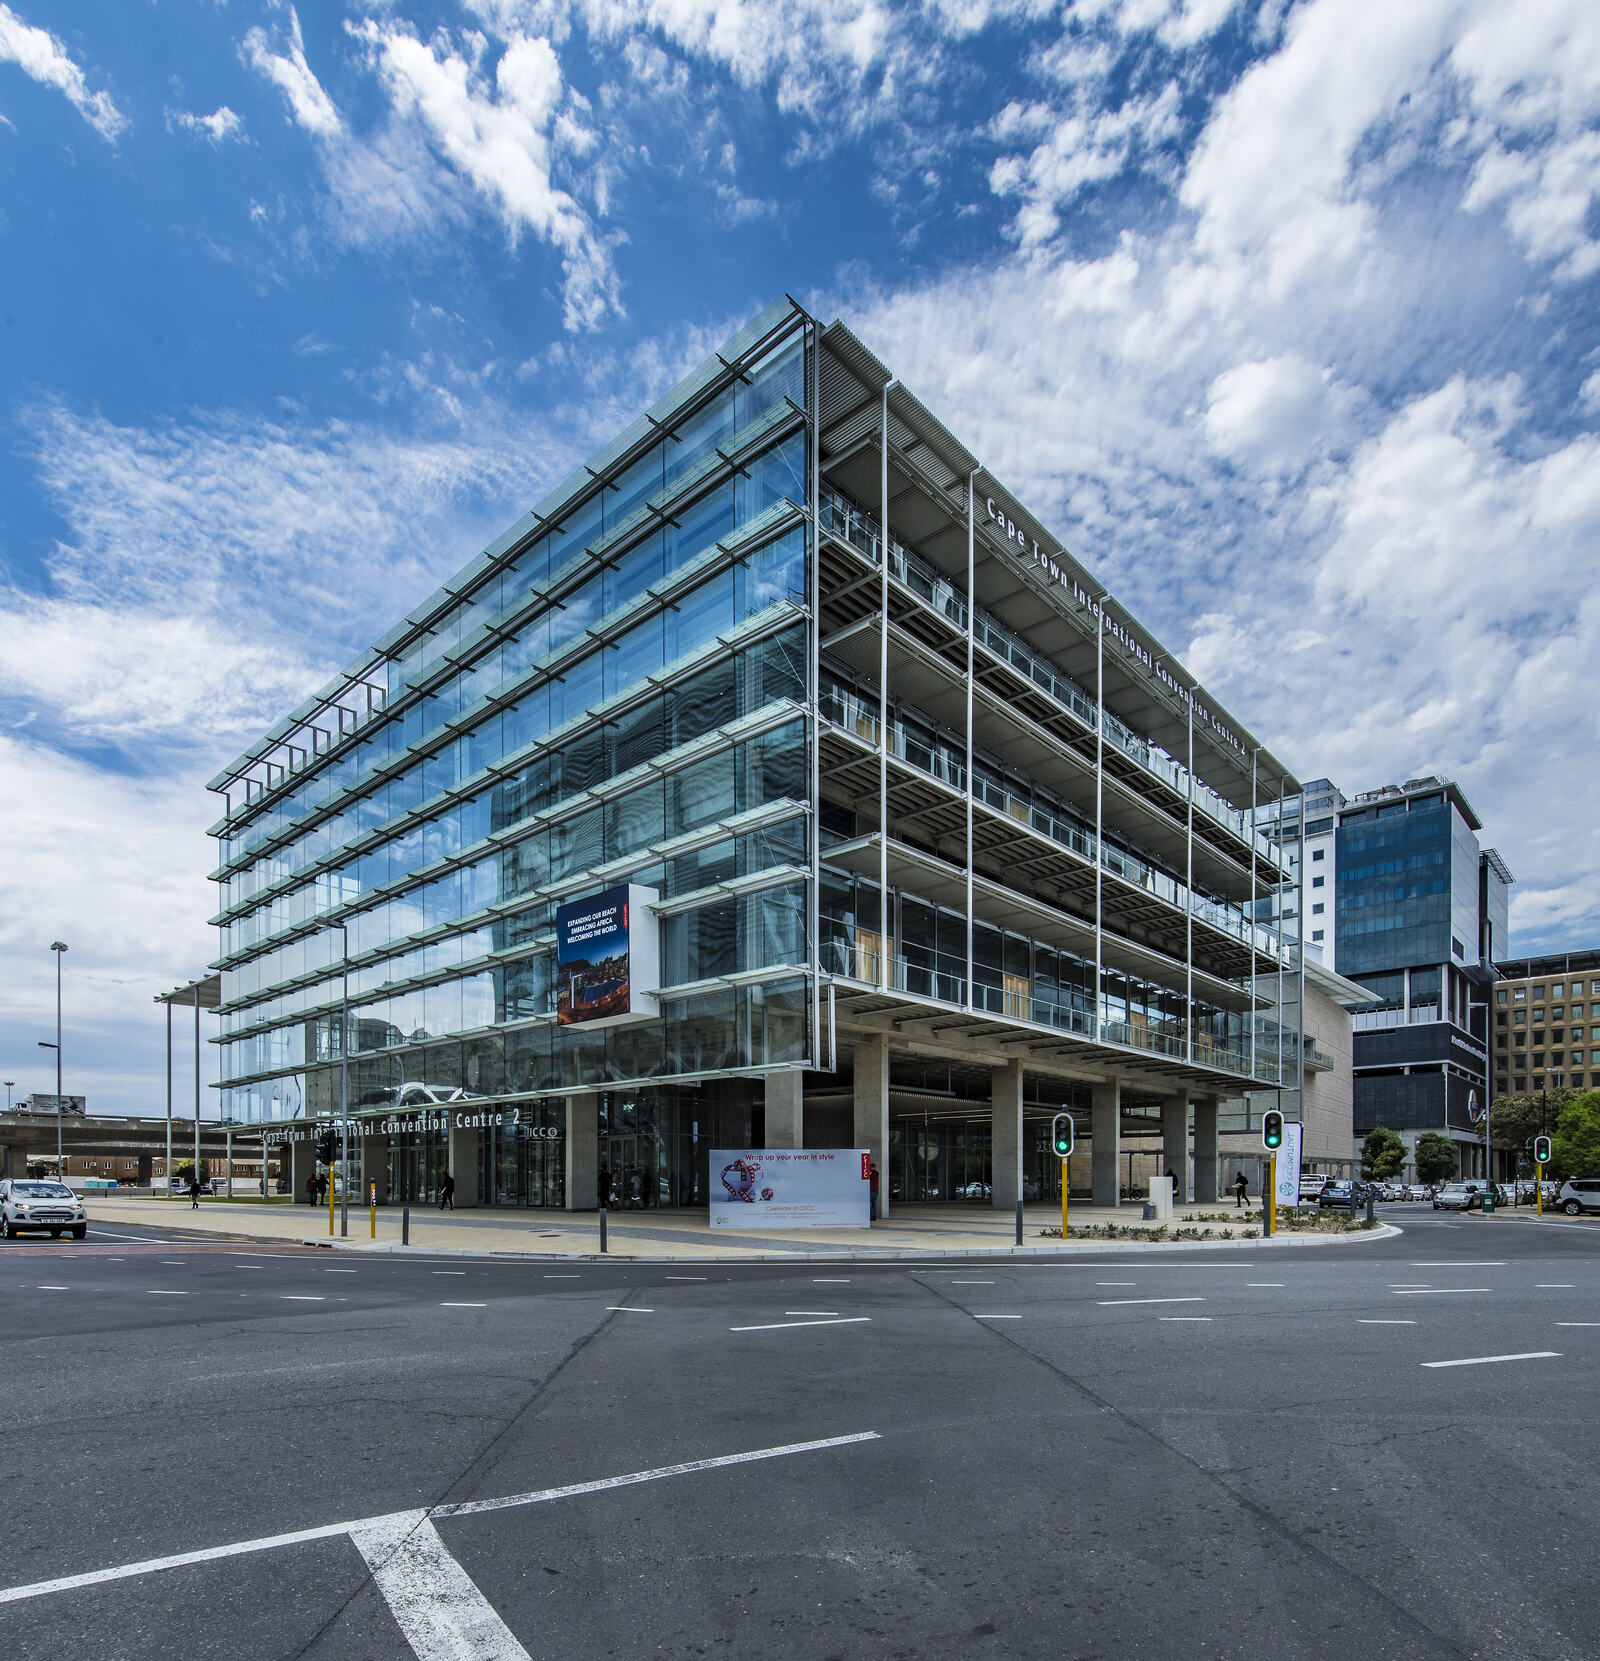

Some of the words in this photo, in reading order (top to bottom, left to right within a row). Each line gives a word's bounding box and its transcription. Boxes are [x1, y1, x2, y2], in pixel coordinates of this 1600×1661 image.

[987, 498, 1024, 546] Cape
[1033, 539, 1067, 588] Town
[1074, 581, 1152, 668] International
[1155, 661, 1208, 721] Convention
[1211, 715, 1238, 748] Centre
[1241, 742, 1246, 755] 2
[567, 915, 591, 927] EXPANDING
[592, 911, 601, 920] OUR
[602, 907, 617, 917] REACH
[571, 922, 596, 934] EMBRACING
[597, 917, 612, 927] AFRICA
[567, 931, 593, 943] WELCOMING
[602, 924, 617, 934] WORLD
[381, 1114, 447, 1134] Convention
[456, 1112, 502, 1129] Centre
[513, 1108, 520, 1125] 2
